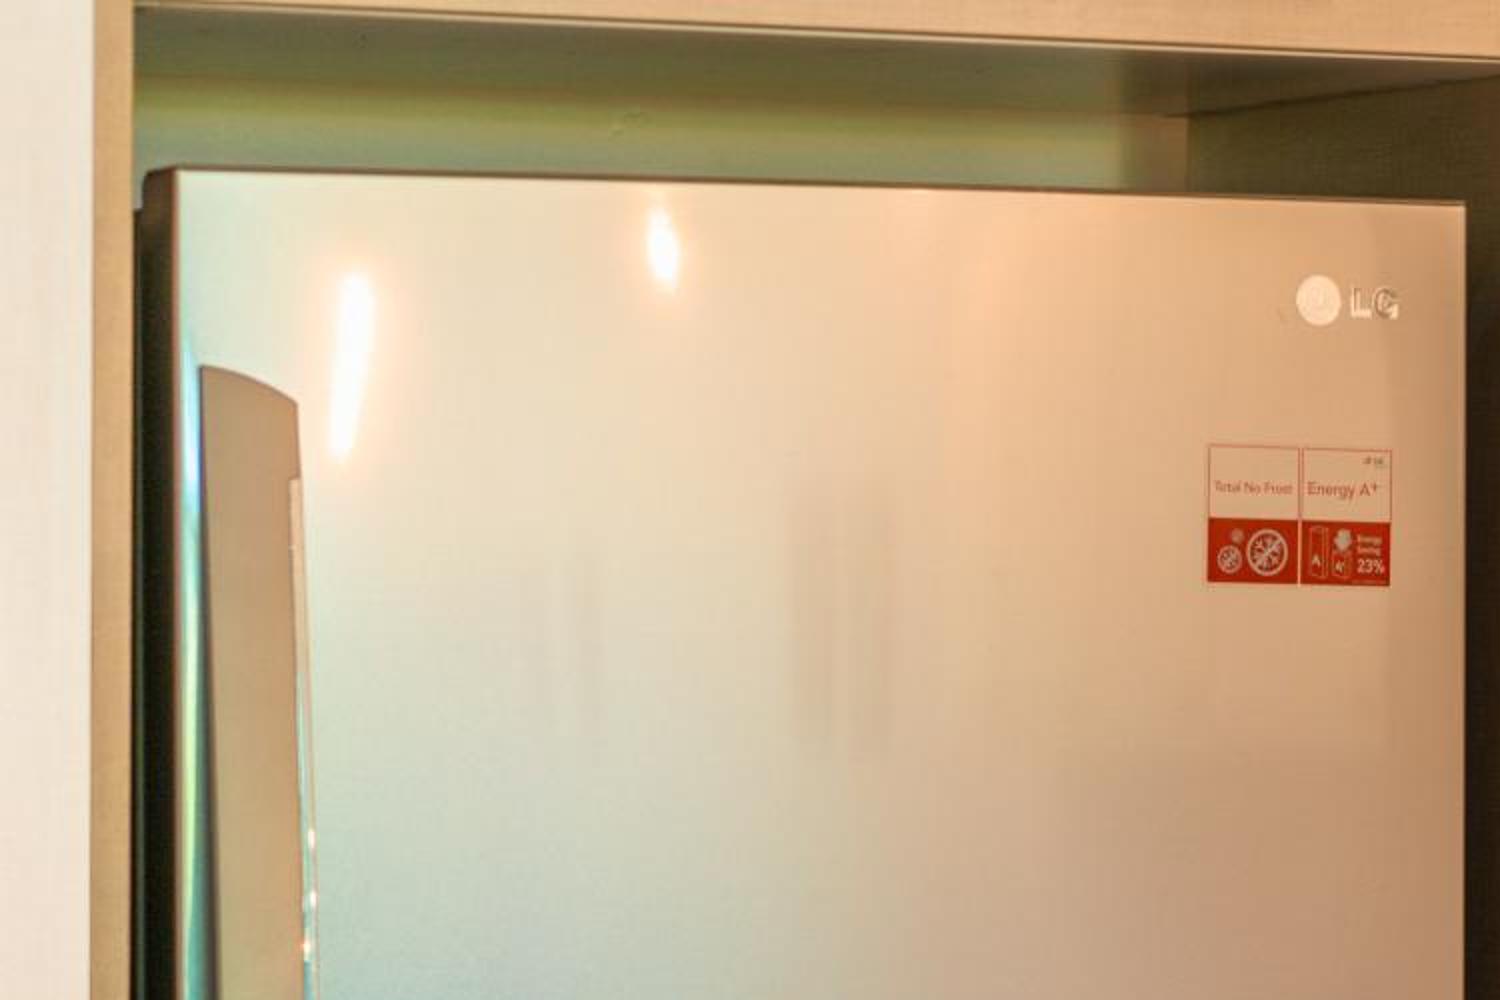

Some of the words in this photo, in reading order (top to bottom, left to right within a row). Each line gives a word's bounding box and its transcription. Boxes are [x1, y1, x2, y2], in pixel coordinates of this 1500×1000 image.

[1350, 287, 1399, 319] LG
[1214, 480, 1241, 493] Total
[1244, 482, 1261, 494] No
[1264, 483, 1293, 495] Frost
[1307, 481, 1354, 499] Energy
[1357, 558, 1386, 574] 23%
